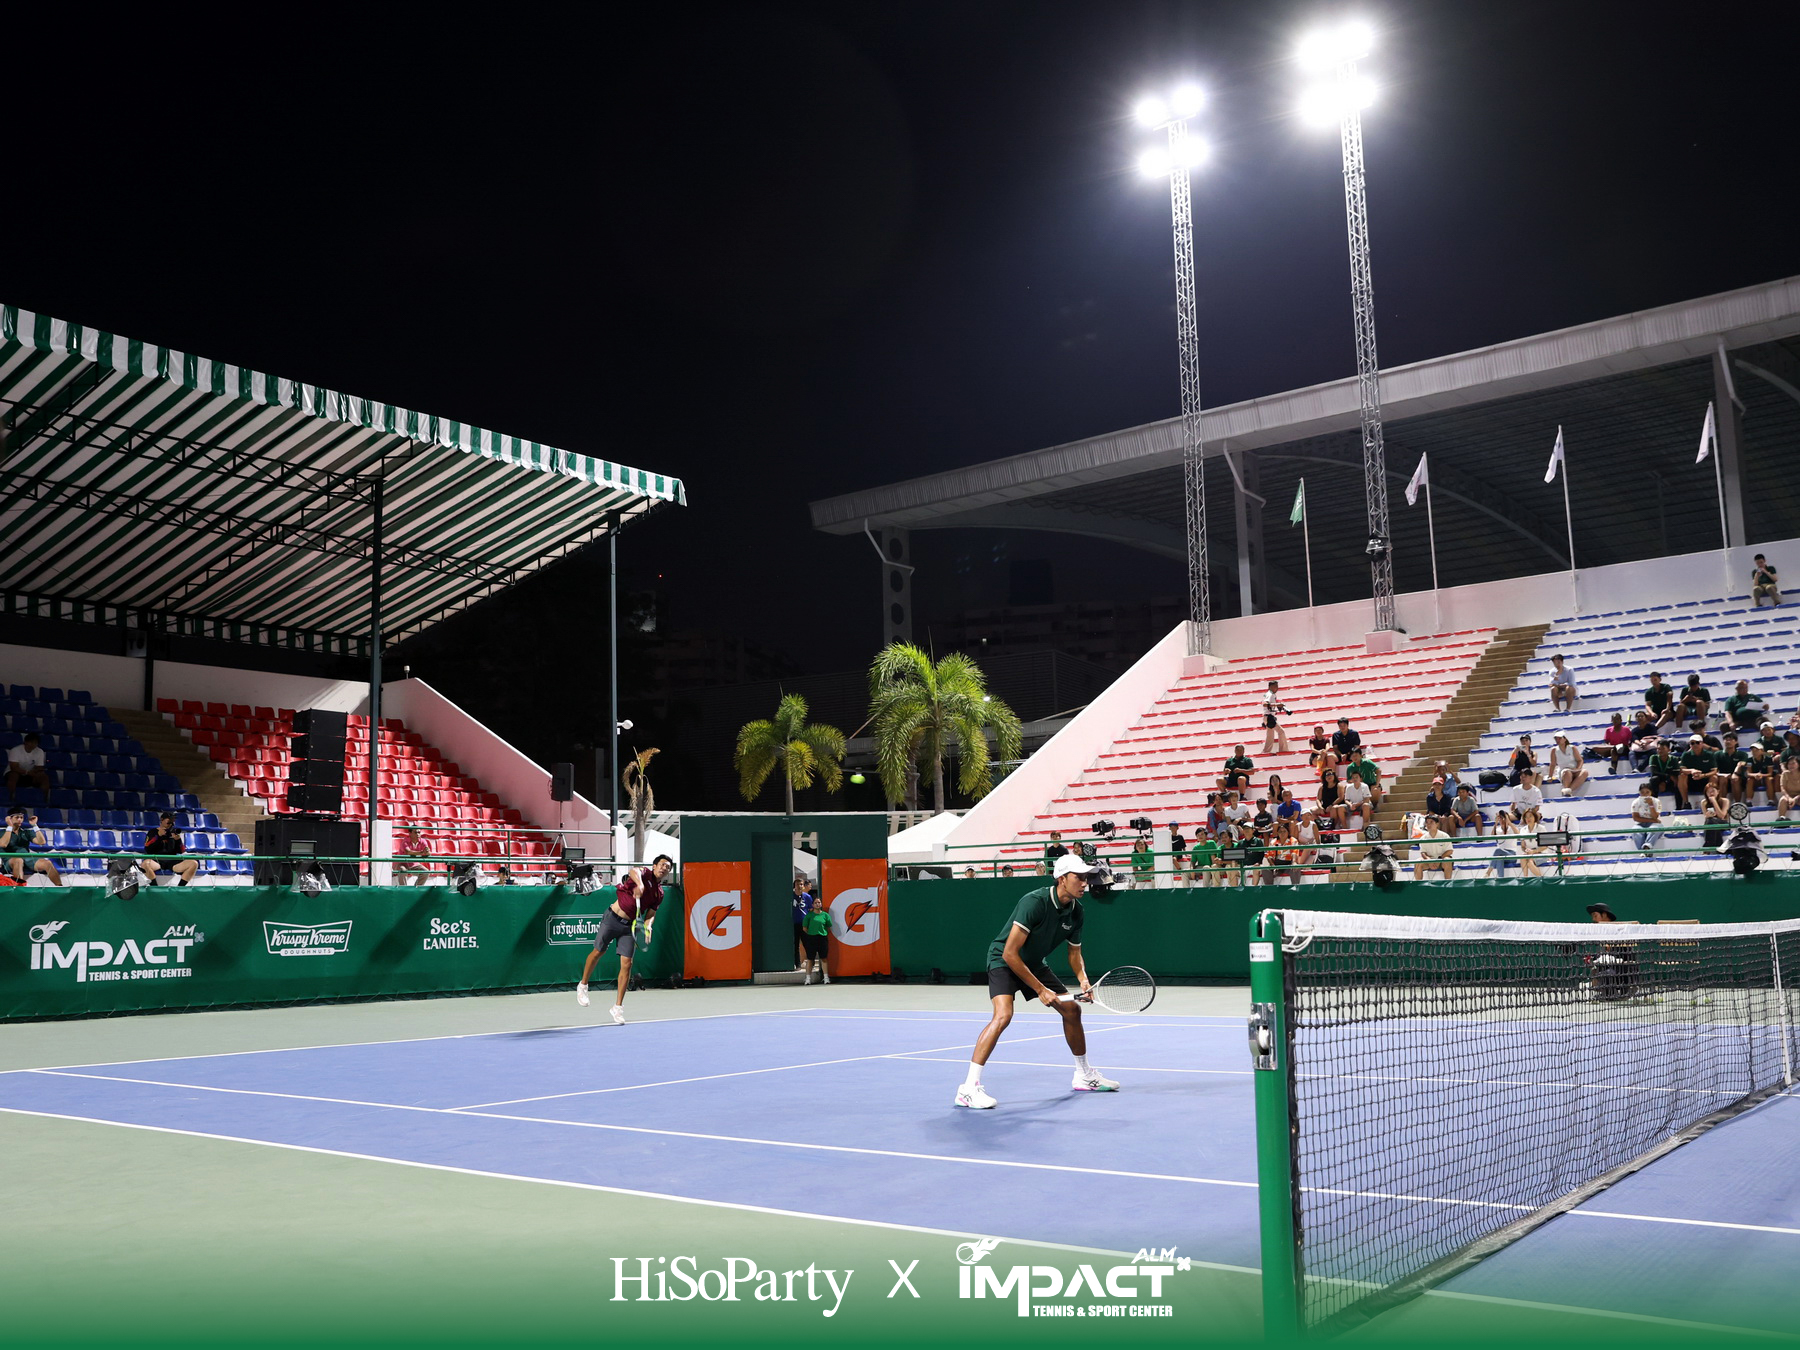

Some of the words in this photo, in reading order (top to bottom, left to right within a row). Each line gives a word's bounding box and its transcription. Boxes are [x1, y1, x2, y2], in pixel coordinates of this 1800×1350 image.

[430, 917, 471, 935] See's
[689, 890, 743, 951] G
[828, 886, 881, 947] G
[163, 924, 197, 938] ALM
[270, 929, 311, 948] Krispy
[309, 928, 347, 945] Kreme
[423, 936, 477, 951] CANDIES
[30, 938, 194, 982] IMPACT
[89, 971, 121, 982] TENNIS
[122, 970, 130, 980] &
[131, 969, 160, 980] SPORT
[160, 968, 192, 979] CENTER
